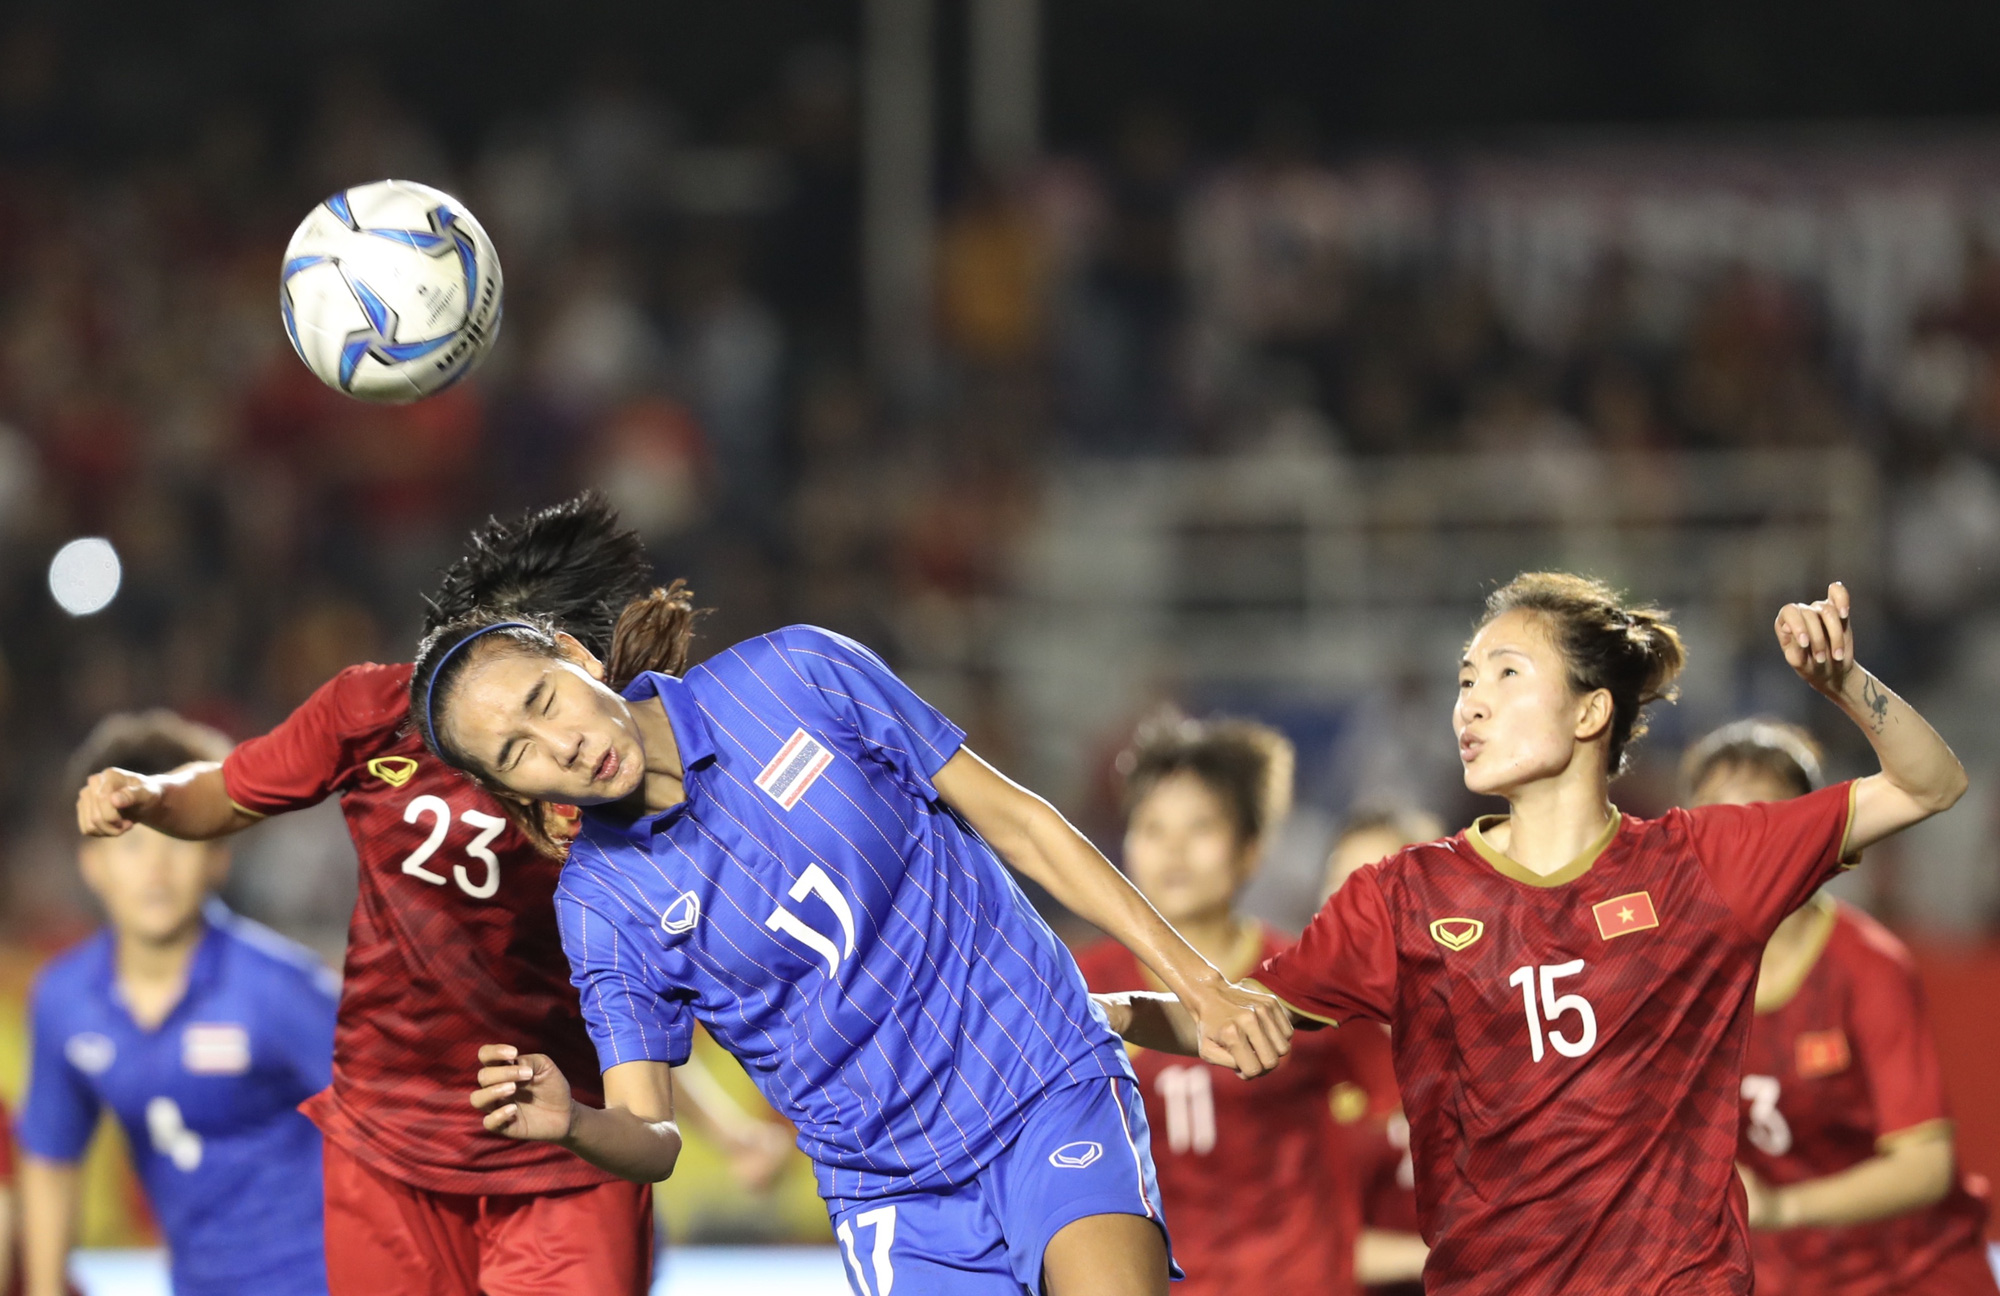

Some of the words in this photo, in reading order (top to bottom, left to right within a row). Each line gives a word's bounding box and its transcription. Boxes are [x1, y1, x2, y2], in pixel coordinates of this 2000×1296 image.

[401, 794, 506, 899] 23
[764, 862, 856, 980] 17
[1508, 958, 1598, 1063] 15
[1155, 1065, 1217, 1156] 11
[1740, 1073, 1793, 1156] 3
[836, 1205, 897, 1296] 17
